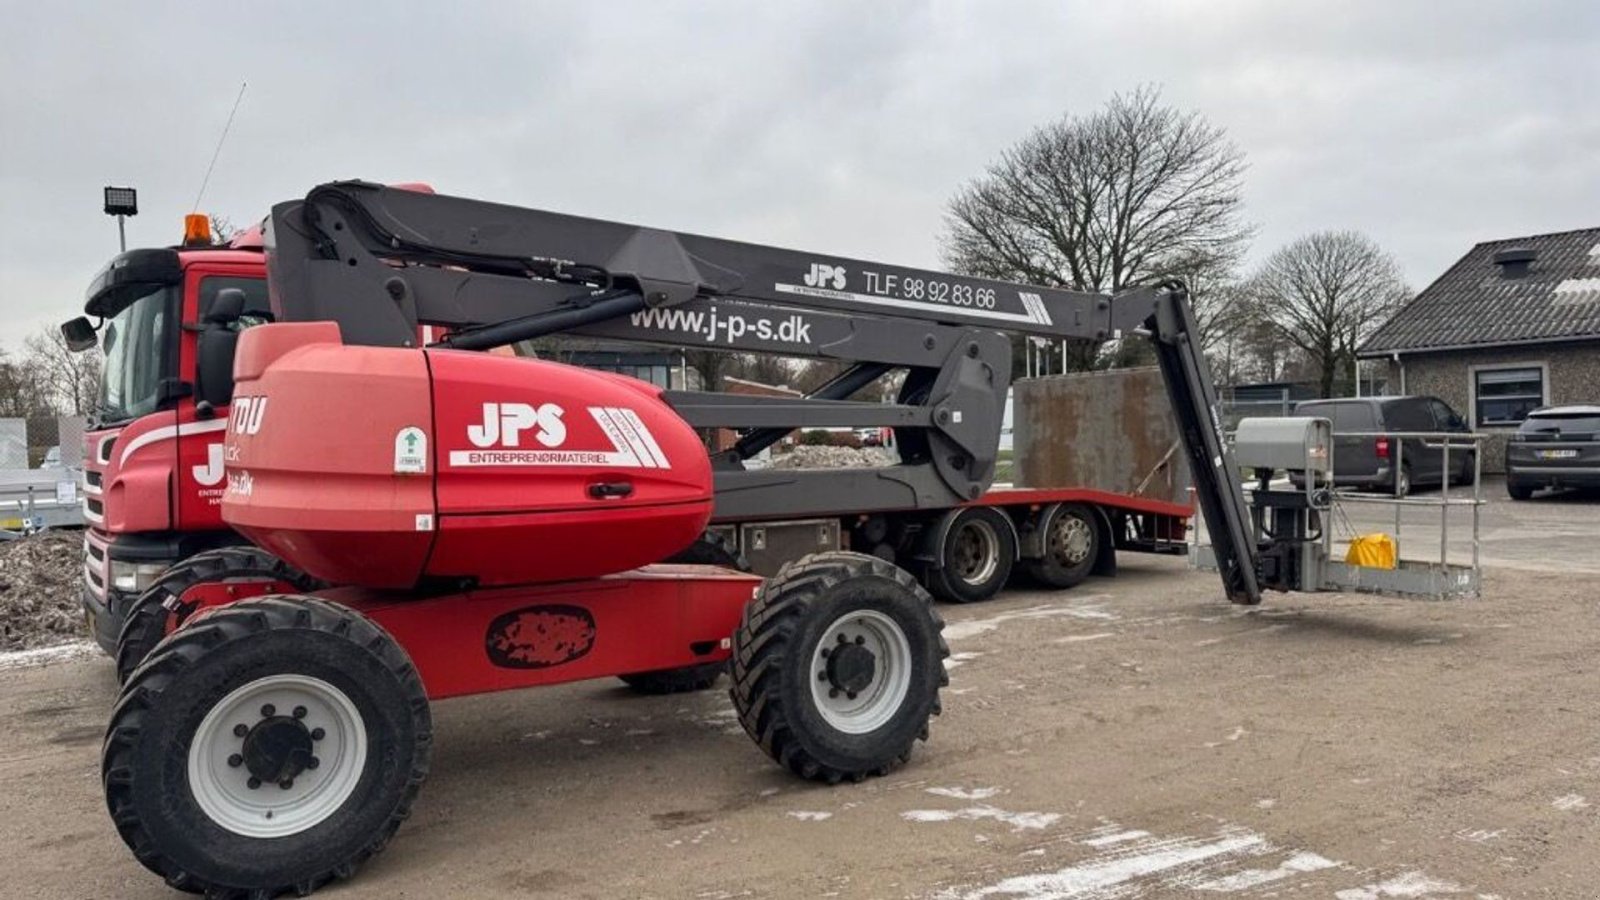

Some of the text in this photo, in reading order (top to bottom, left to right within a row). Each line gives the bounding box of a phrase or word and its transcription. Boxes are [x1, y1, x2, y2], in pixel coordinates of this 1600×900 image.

[803, 262, 847, 291] JPS
[862, 270, 899, 297] TLF.
[903, 277, 925, 299] 98
[928, 281, 950, 303] 92
[952, 284, 973, 306] 83
[976, 288, 996, 309] 66
[630, 306, 812, 344] www.j-p-s.dk
[467, 402, 567, 448] JPS
[468, 452, 610, 465] ENTREPRENØRMATERIEL
